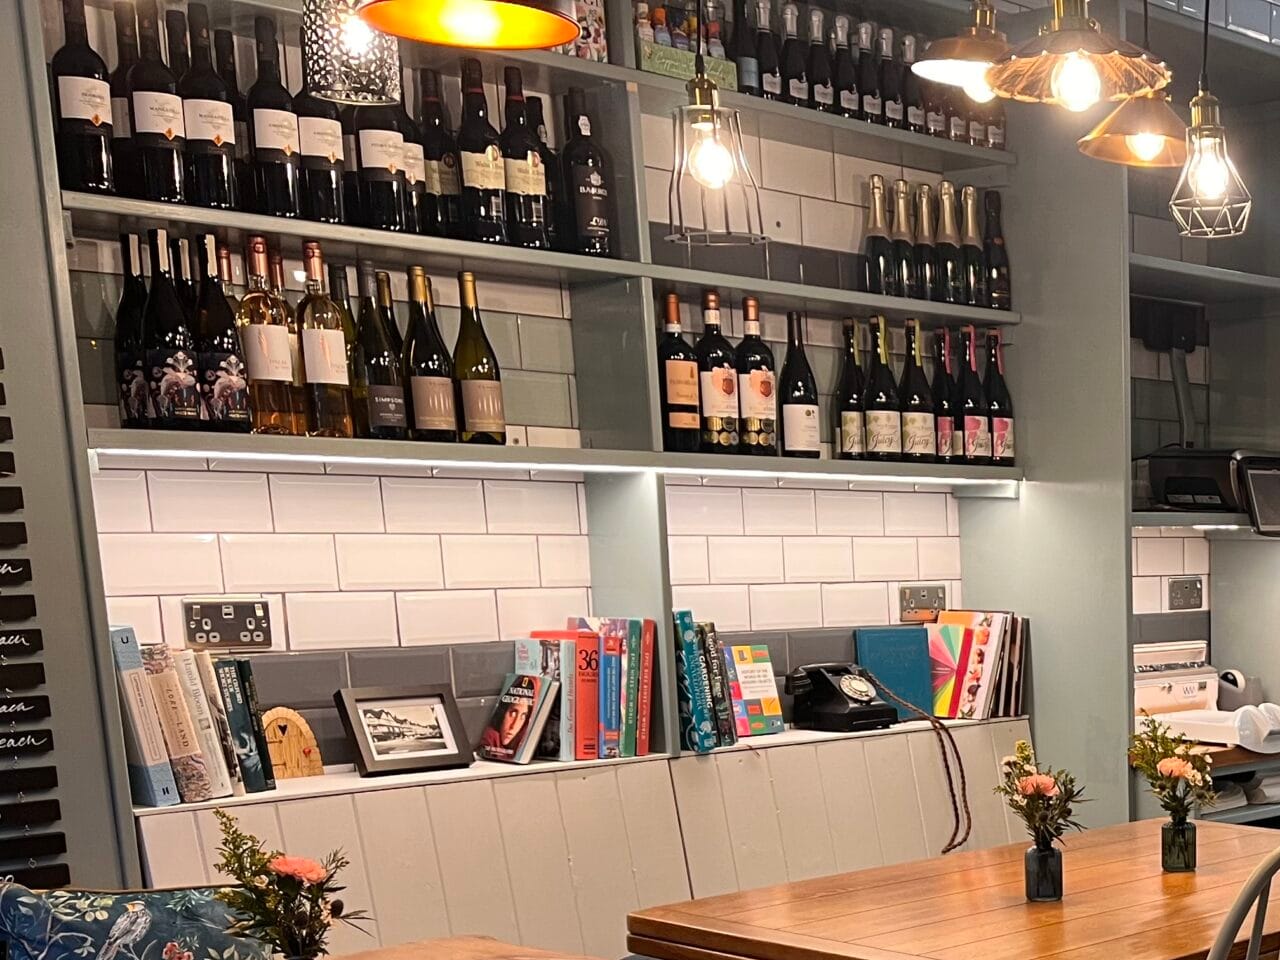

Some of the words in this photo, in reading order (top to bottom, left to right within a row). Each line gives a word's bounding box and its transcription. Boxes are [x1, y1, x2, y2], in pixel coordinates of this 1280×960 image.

[0, 634, 30, 646] ach
[707, 632, 717, 657] Food
[183, 658, 197, 683] Harold
[579, 649, 599, 671] 36
[699, 655, 713, 709] GARDENING
[0, 702, 35, 713] ach
[176, 721, 190, 748] LAND
